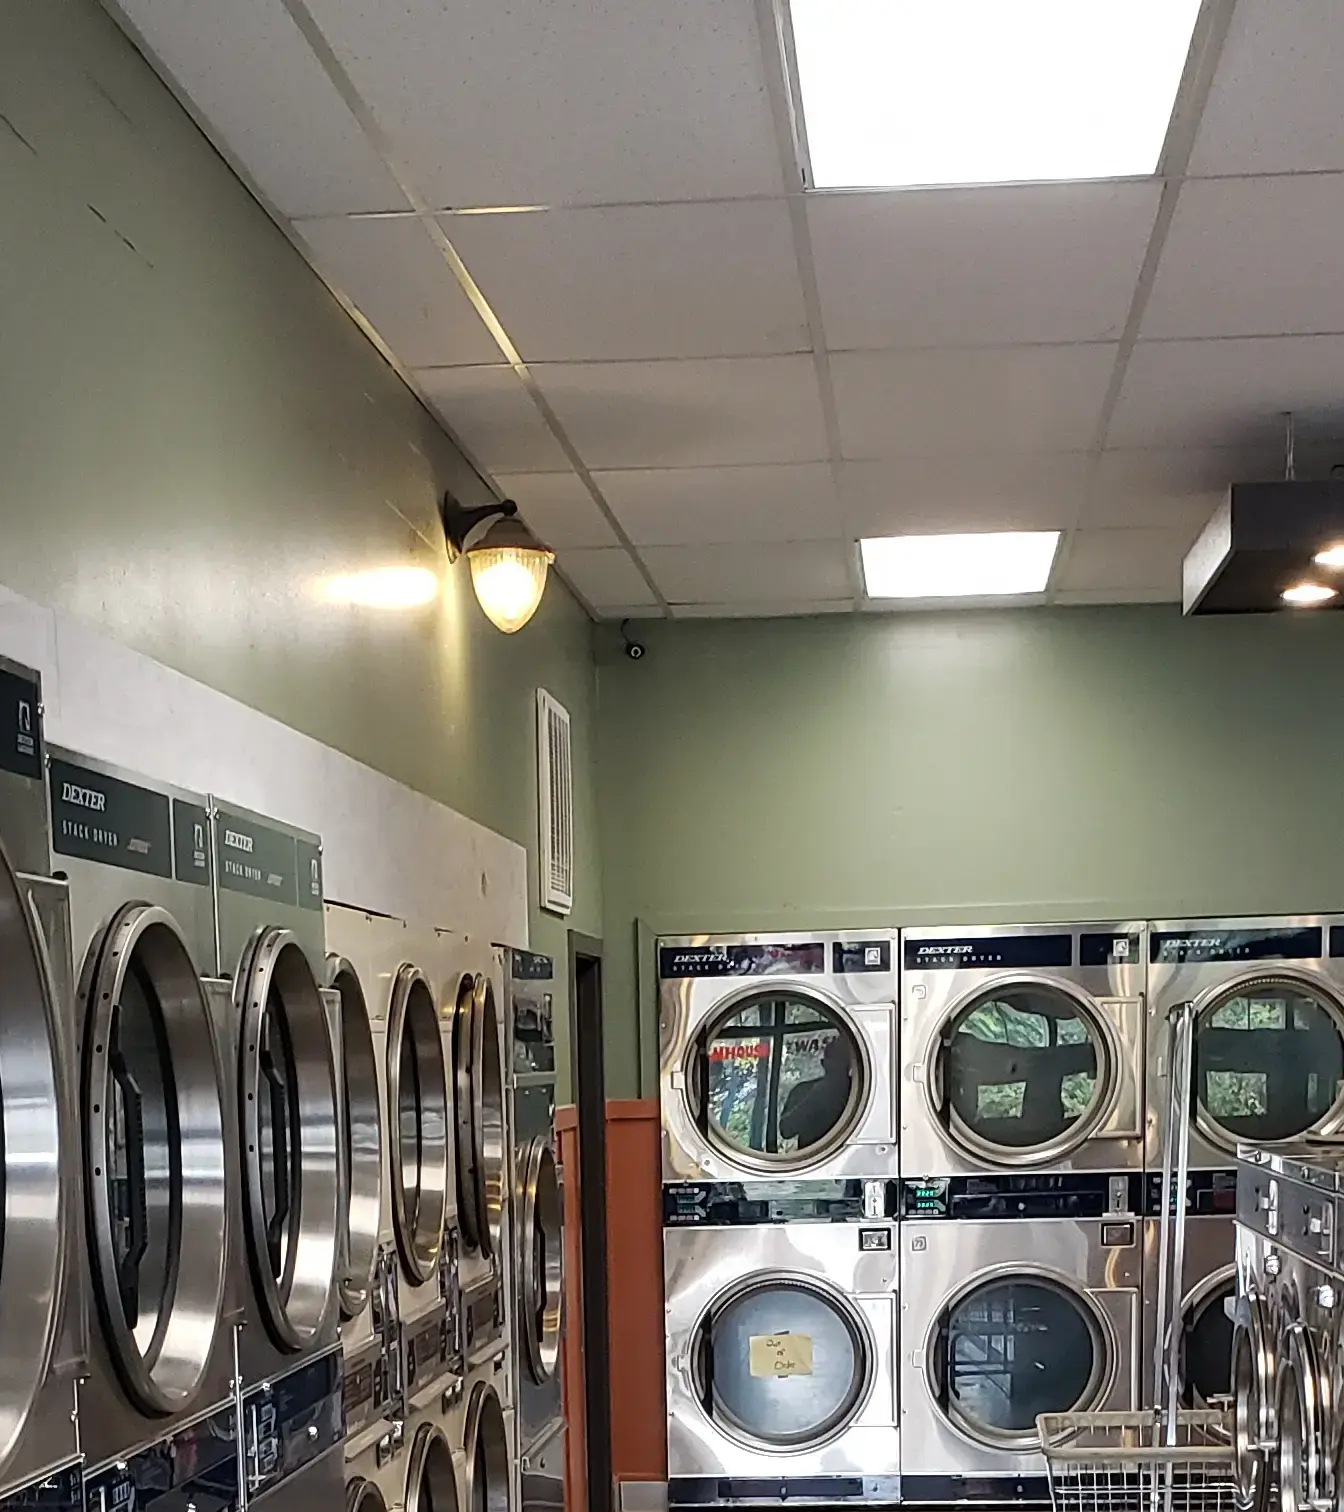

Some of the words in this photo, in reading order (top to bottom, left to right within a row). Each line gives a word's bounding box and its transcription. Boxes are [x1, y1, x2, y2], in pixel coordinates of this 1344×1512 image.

[62, 782, 105, 812] DEXTER
[62, 819, 89, 840] STACK
[93, 829, 118, 847] DRYER
[224, 829, 253, 853] DEXTER
[917, 945, 973, 955] DEXTER
[1163, 939, 1221, 948] DEXTER
[673, 954, 729, 963] DEXTER
